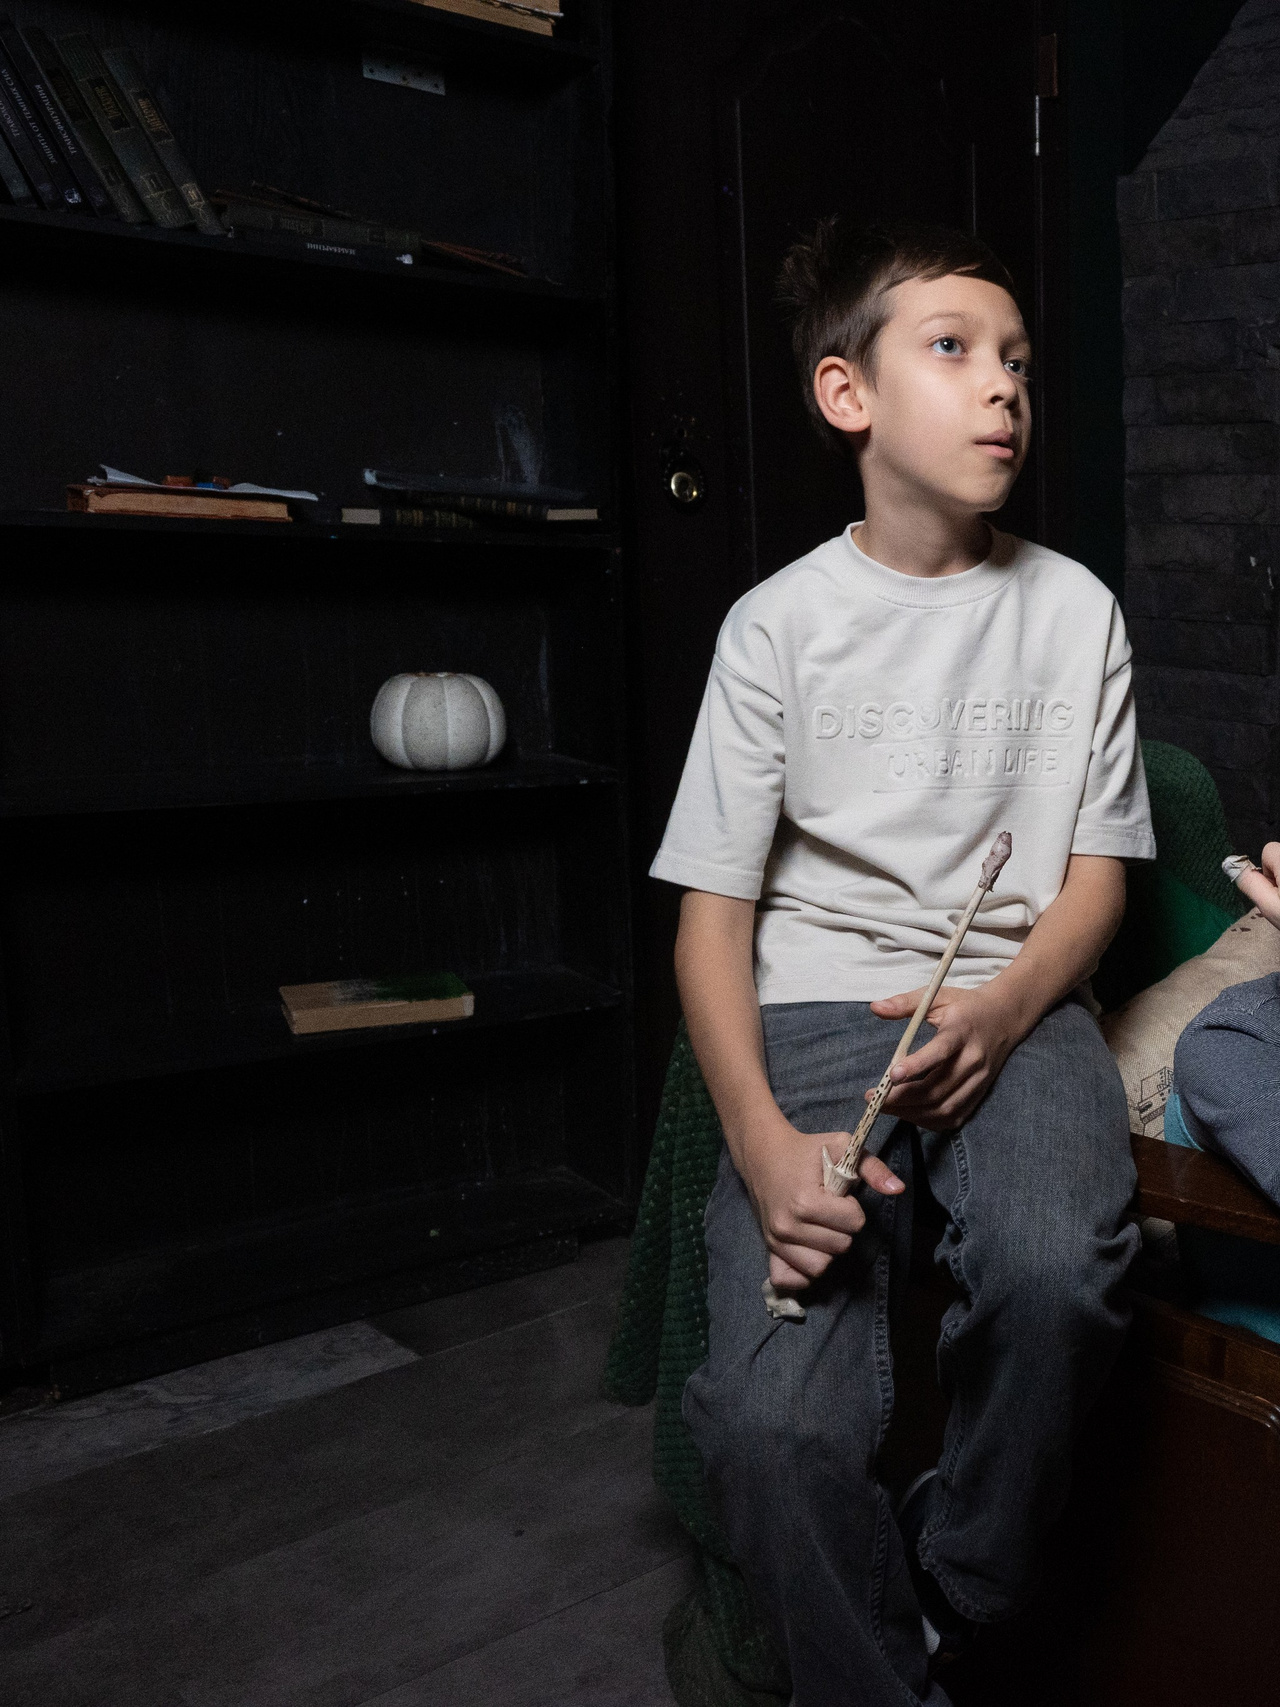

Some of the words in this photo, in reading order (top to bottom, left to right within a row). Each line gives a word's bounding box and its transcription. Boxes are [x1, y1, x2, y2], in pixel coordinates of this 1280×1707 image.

[813, 698, 1074, 739] DISCOVERING
[888, 748, 997, 779] URBAN
[1003, 747, 1059, 776] LIFE
